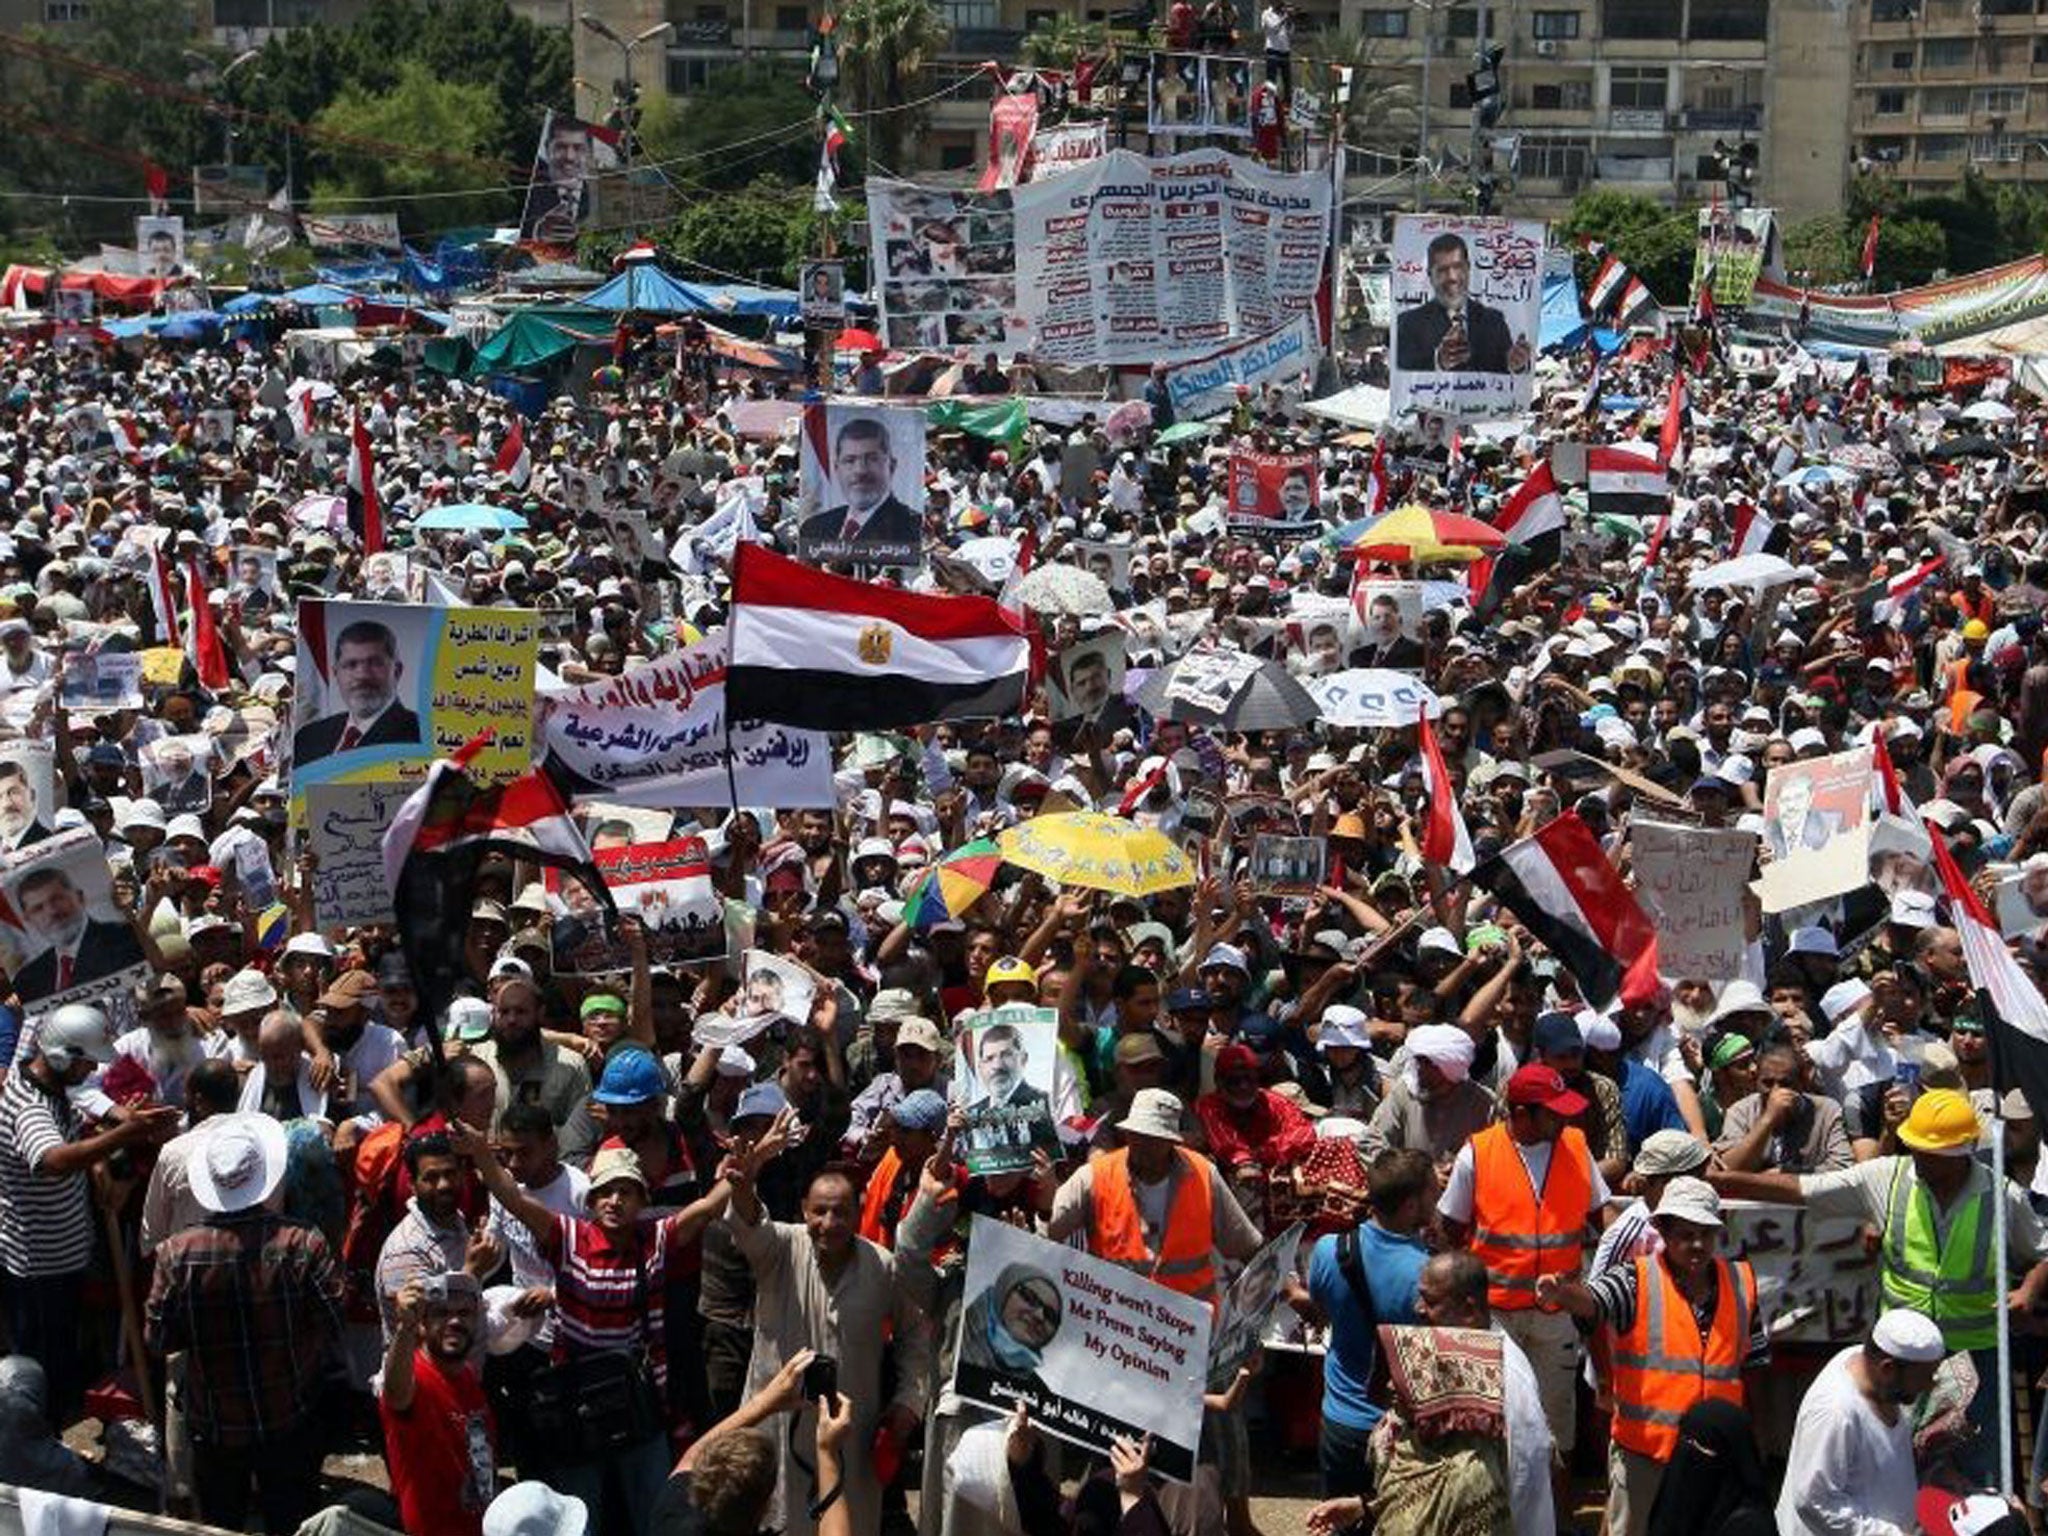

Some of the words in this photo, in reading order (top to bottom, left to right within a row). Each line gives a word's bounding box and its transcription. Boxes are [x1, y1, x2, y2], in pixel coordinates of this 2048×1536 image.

[1160, 180, 1217, 201] الحرس
[1260, 190, 1311, 211] مذبحة
[1453, 378, 1487, 391] محمد
[454, 655, 488, 680] شمس
[500, 731, 527, 752] نعم
[1063, 1268, 1113, 1305] Killing
[1069, 1297, 1092, 1321] Me
[1084, 1331, 1109, 1358] My
[1110, 1343, 1171, 1383] Opinion
